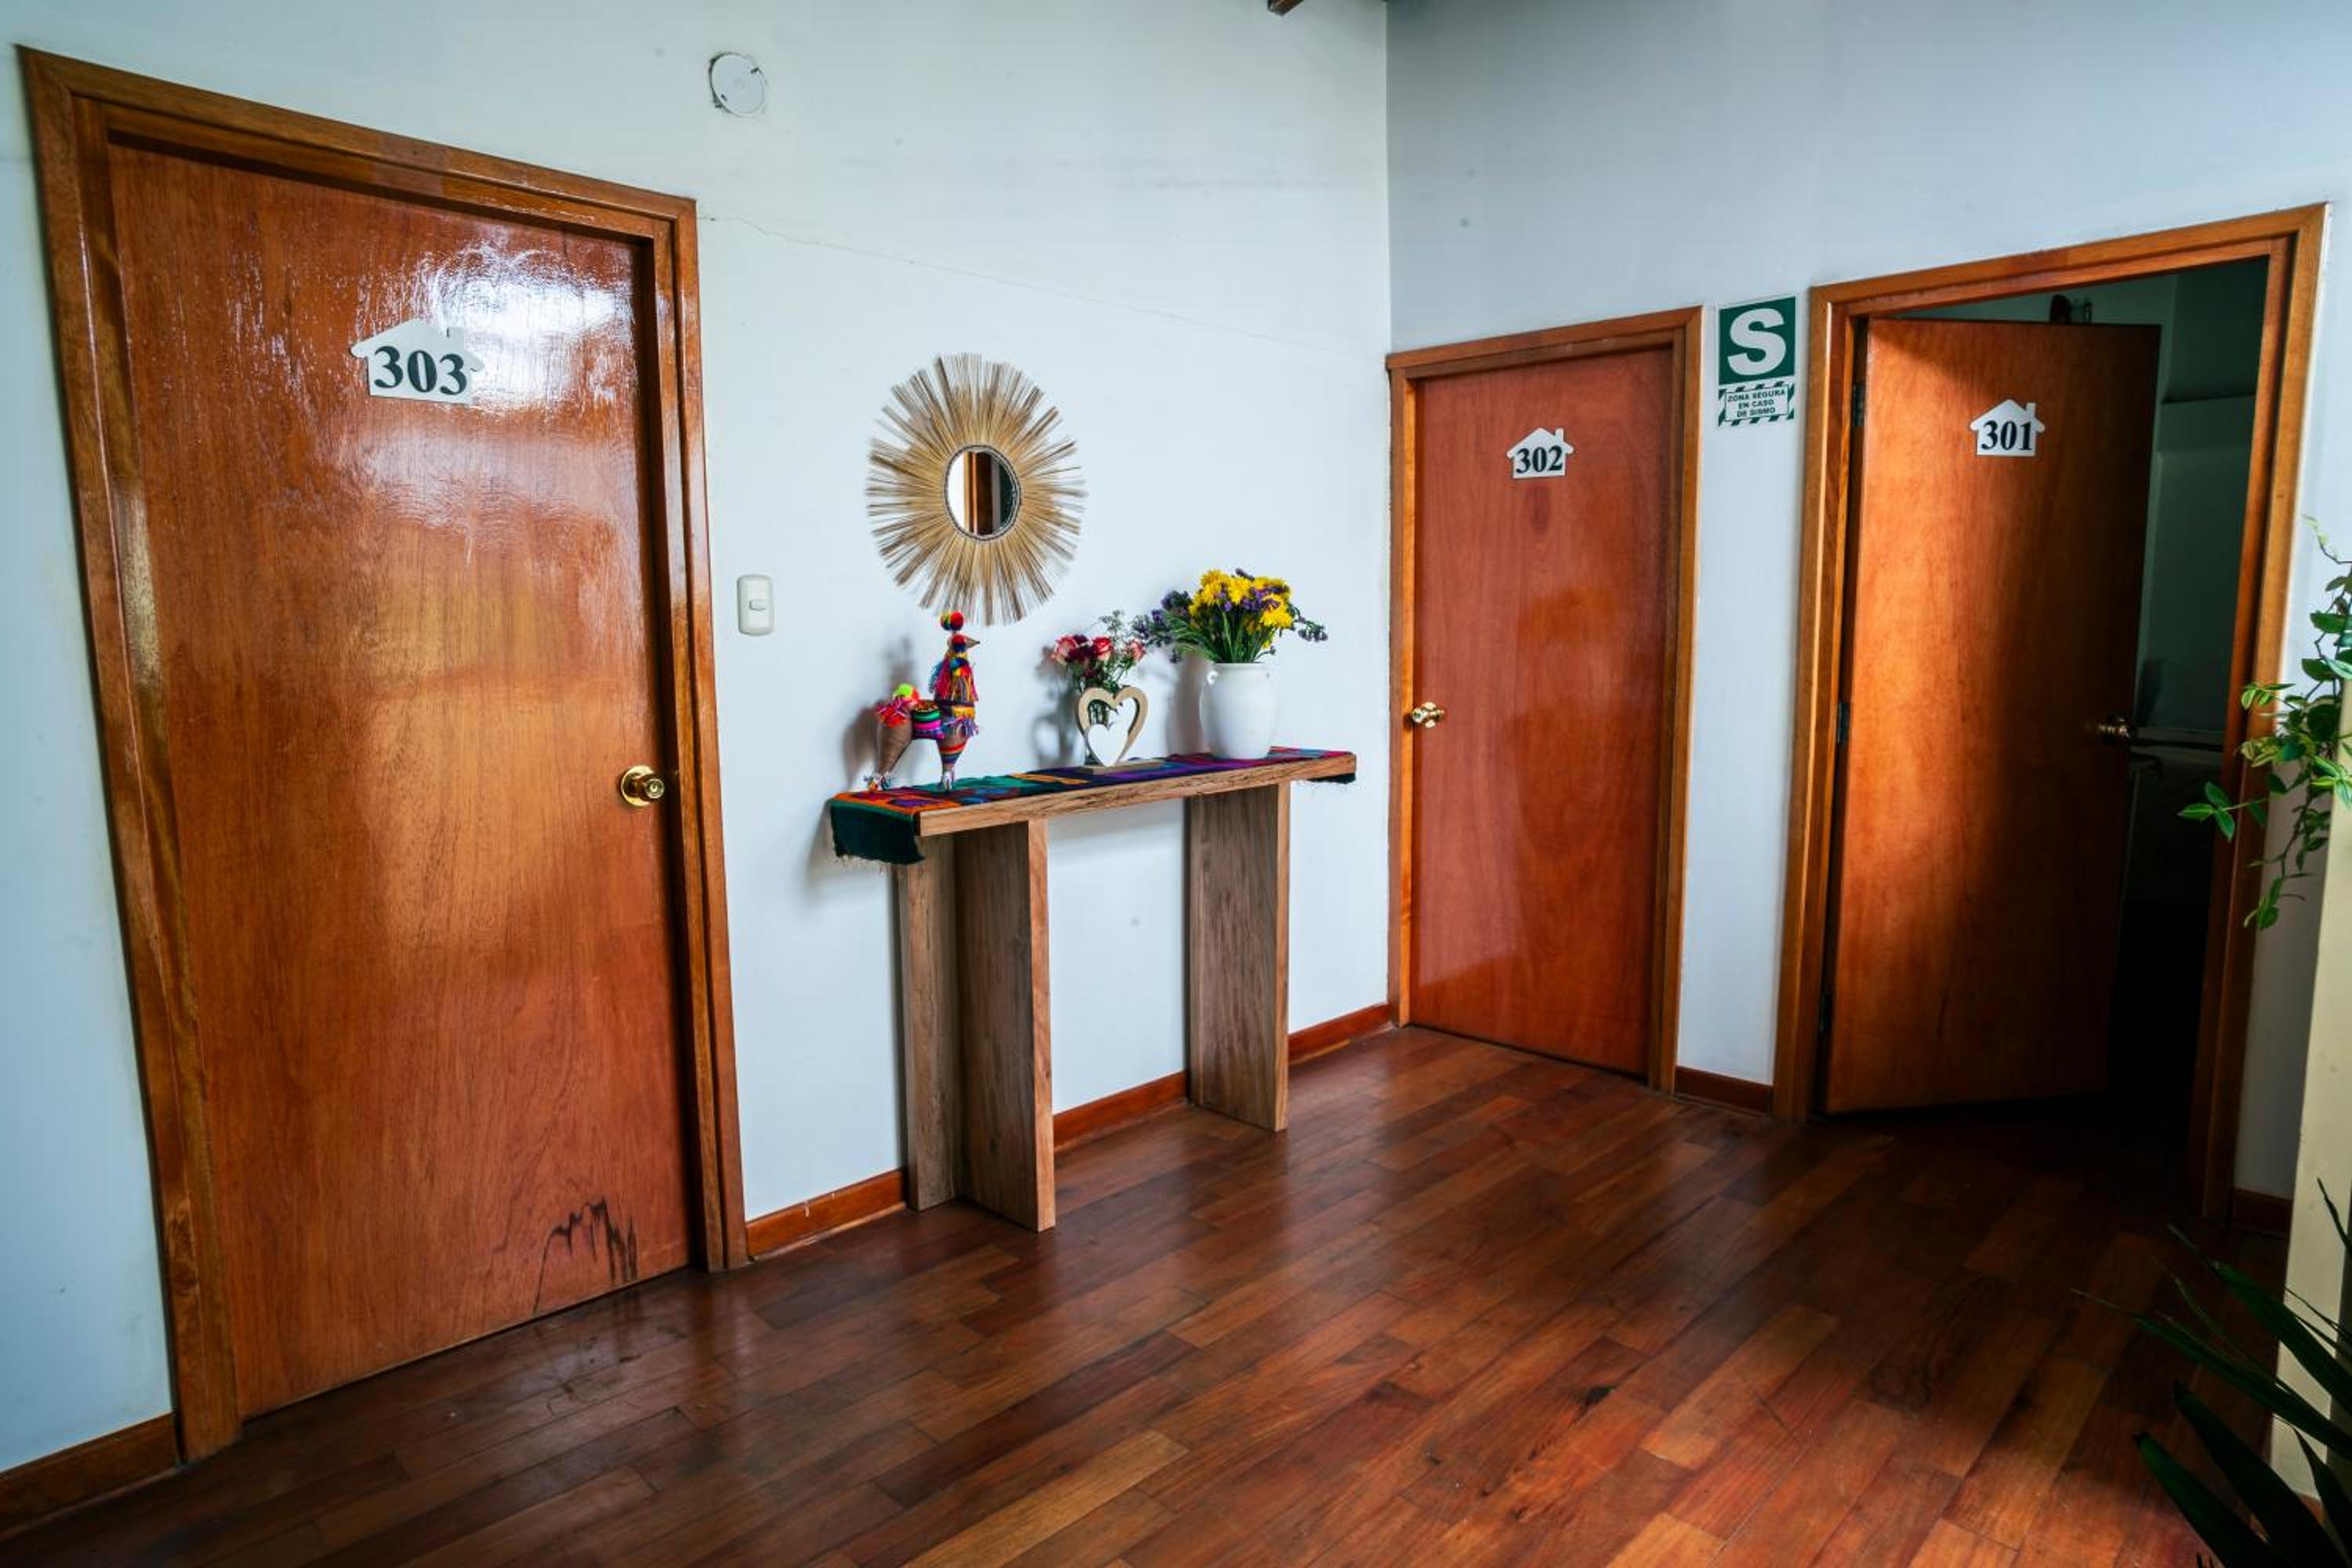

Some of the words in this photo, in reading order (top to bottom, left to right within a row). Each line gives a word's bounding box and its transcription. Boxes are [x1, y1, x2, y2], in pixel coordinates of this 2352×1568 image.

[1727, 307, 1787, 376] S
[374, 346, 467, 396] 303
[1727, 394, 1749, 402] ZONA
[1752, 389, 1785, 399] SEGURA
[1751, 399, 1774, 408] CASO
[1749, 407, 1776, 416] SISMO
[1981, 420, 2033, 451] 301
[1515, 445, 1563, 474] 302
